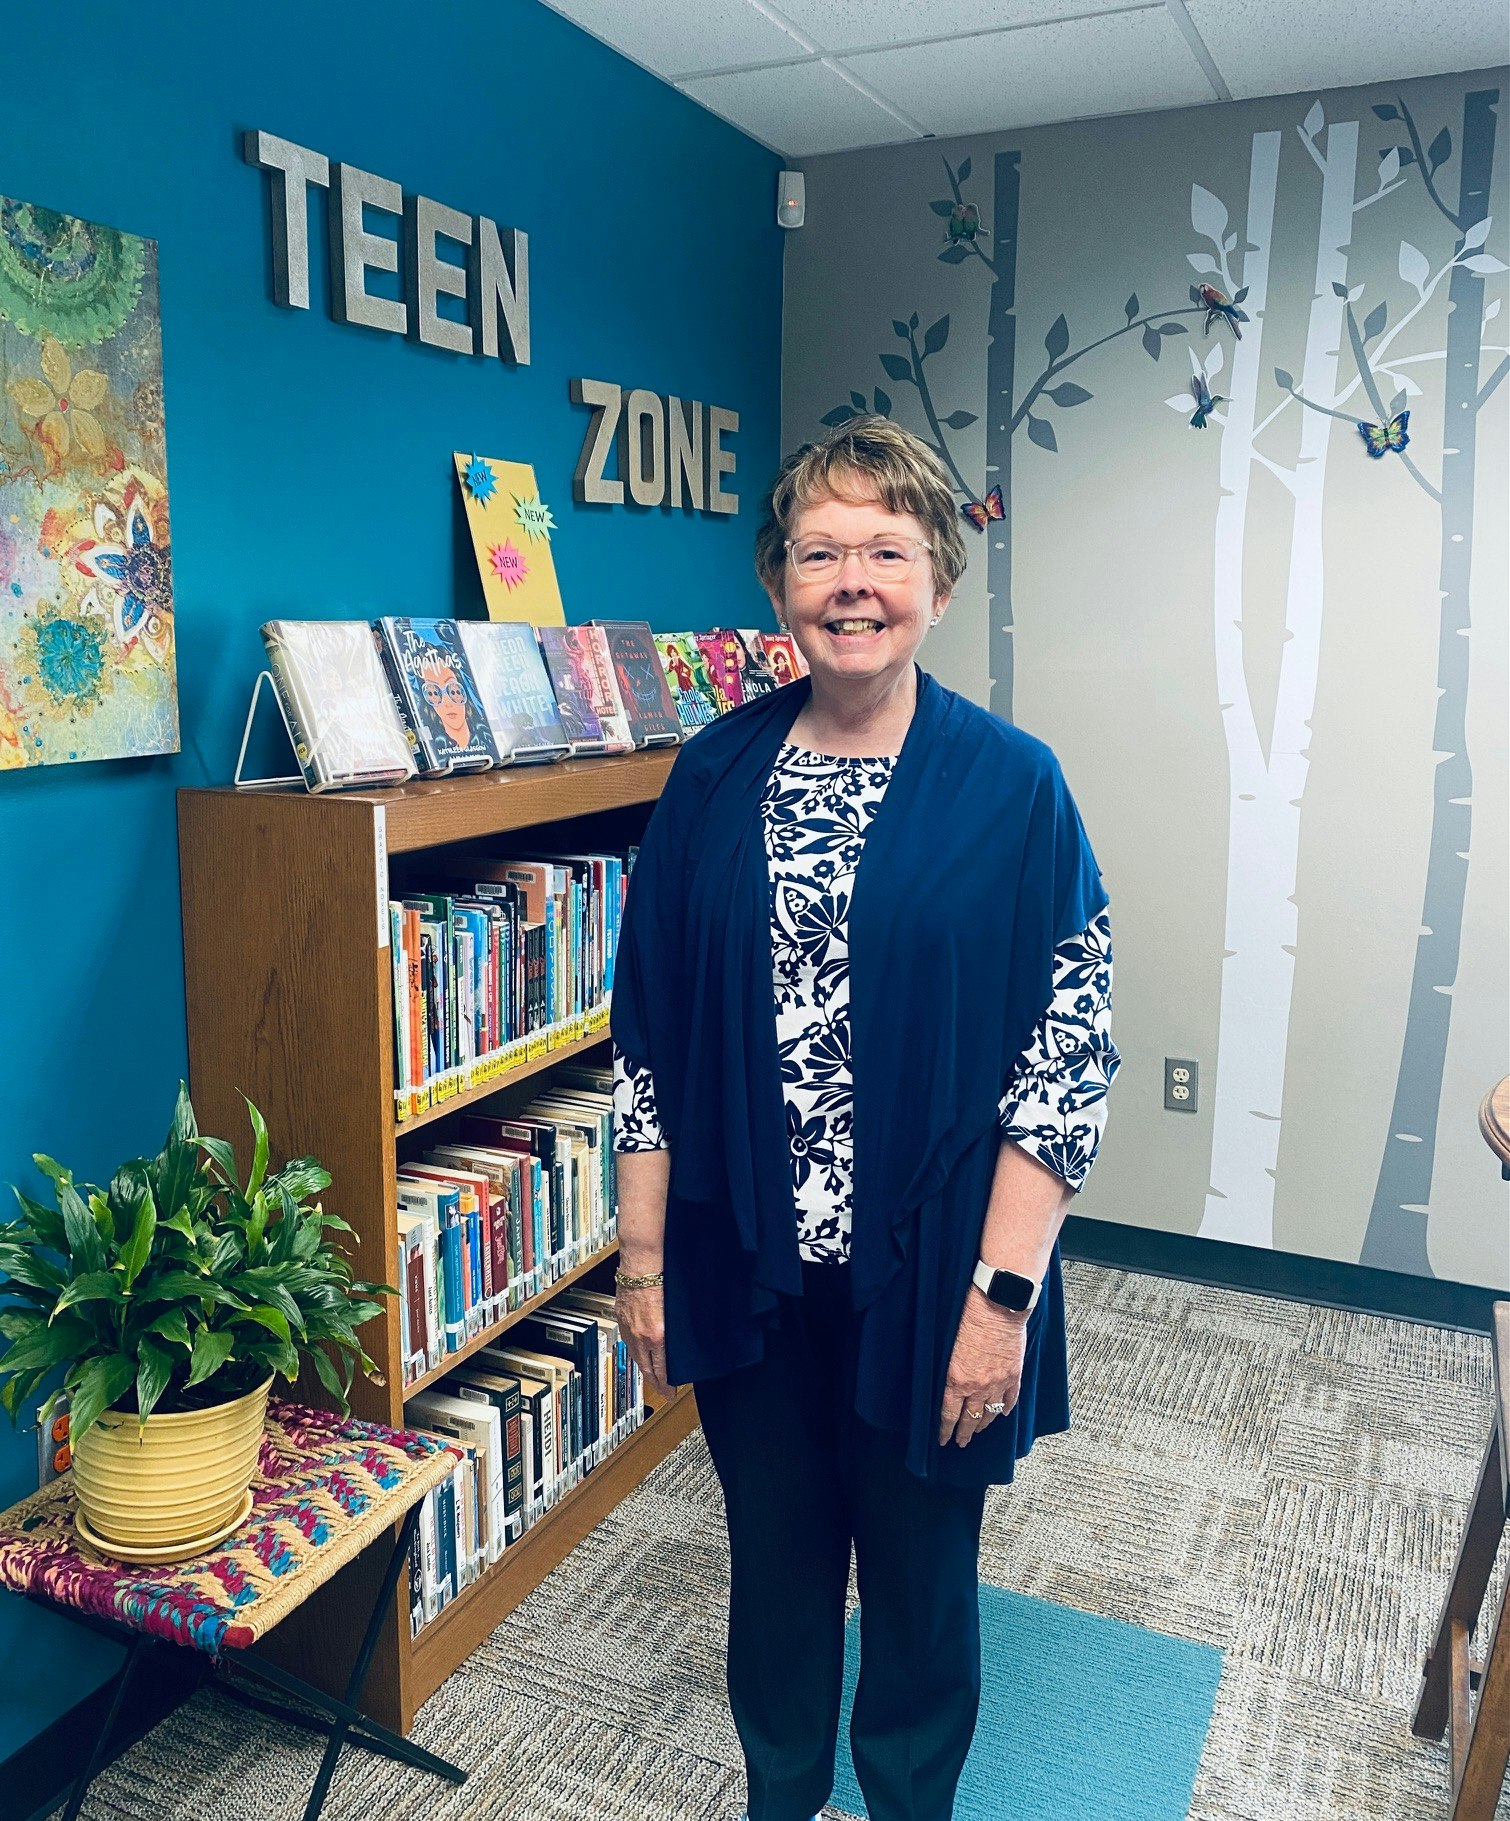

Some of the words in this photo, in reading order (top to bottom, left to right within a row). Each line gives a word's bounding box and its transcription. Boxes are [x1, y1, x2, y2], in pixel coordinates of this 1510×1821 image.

[248, 130, 530, 365] TEEN
[572, 378, 739, 514] ZONE
[472, 469, 487, 486] NEW
[524, 508, 545, 523] NEW
[499, 556, 518, 568] NEW
[403, 630, 426, 652] The
[403, 649, 462, 679] Agathas
[588, 628, 613, 703] HORROR
[497, 694, 549, 719] WHITE
[484, 1241, 492, 1288] FAHRENHEIT
[544, 1409, 552, 1457] HEIDI
